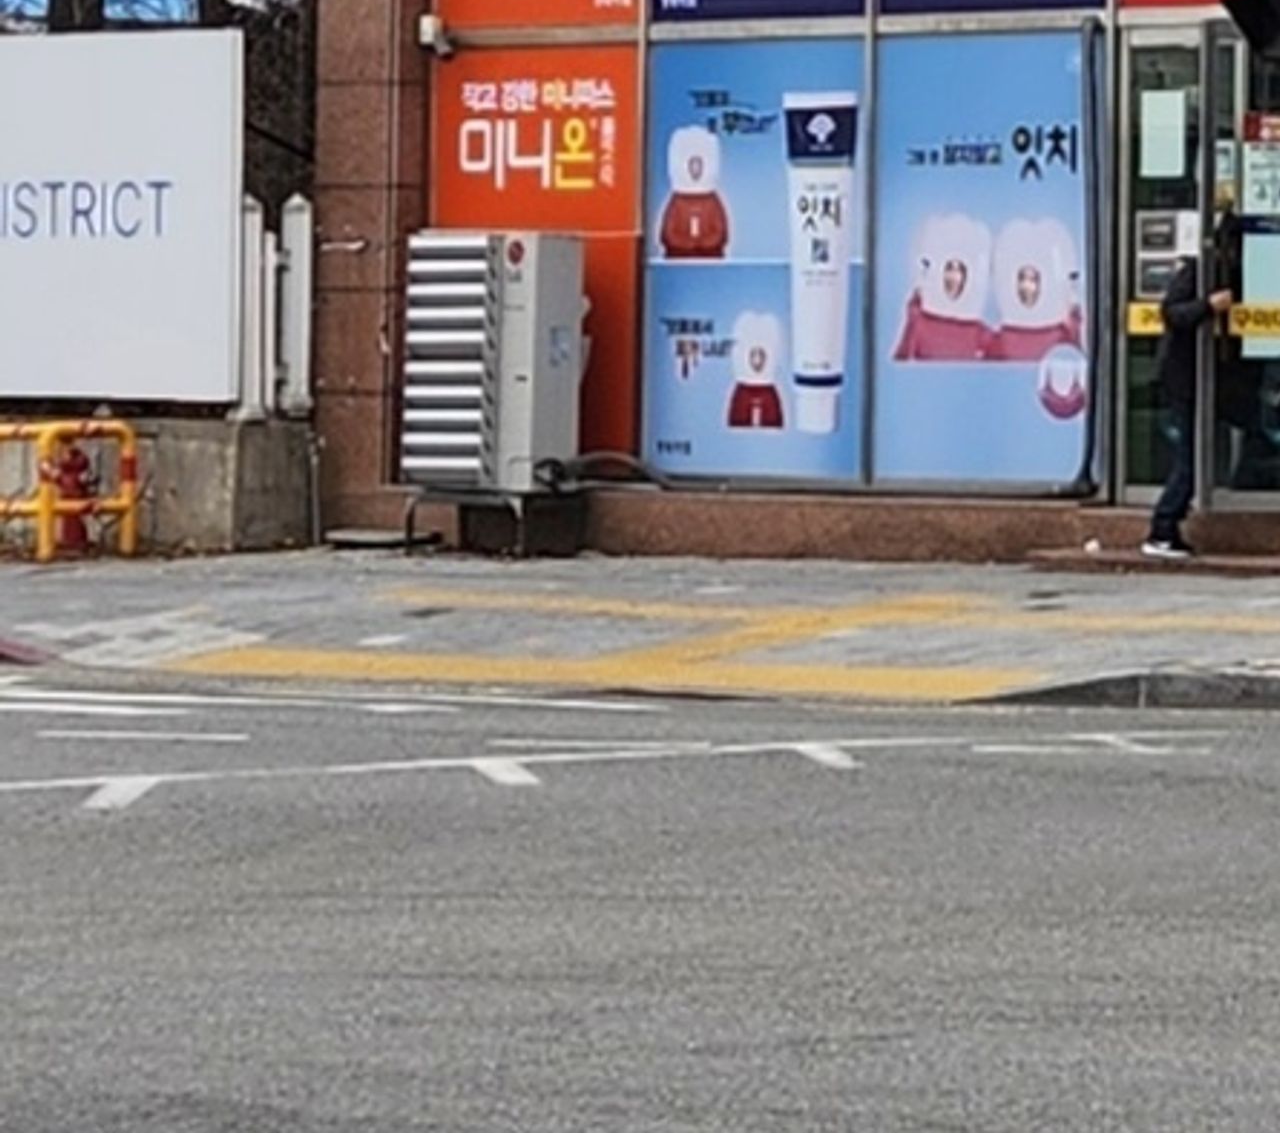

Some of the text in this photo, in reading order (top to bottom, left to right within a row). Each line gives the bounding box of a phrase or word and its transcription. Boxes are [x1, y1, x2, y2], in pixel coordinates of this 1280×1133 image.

[460, 118, 595, 191] 미니온
[1012, 124, 1078, 181] 잇치
[1, 181, 173, 238] ISTRICT
